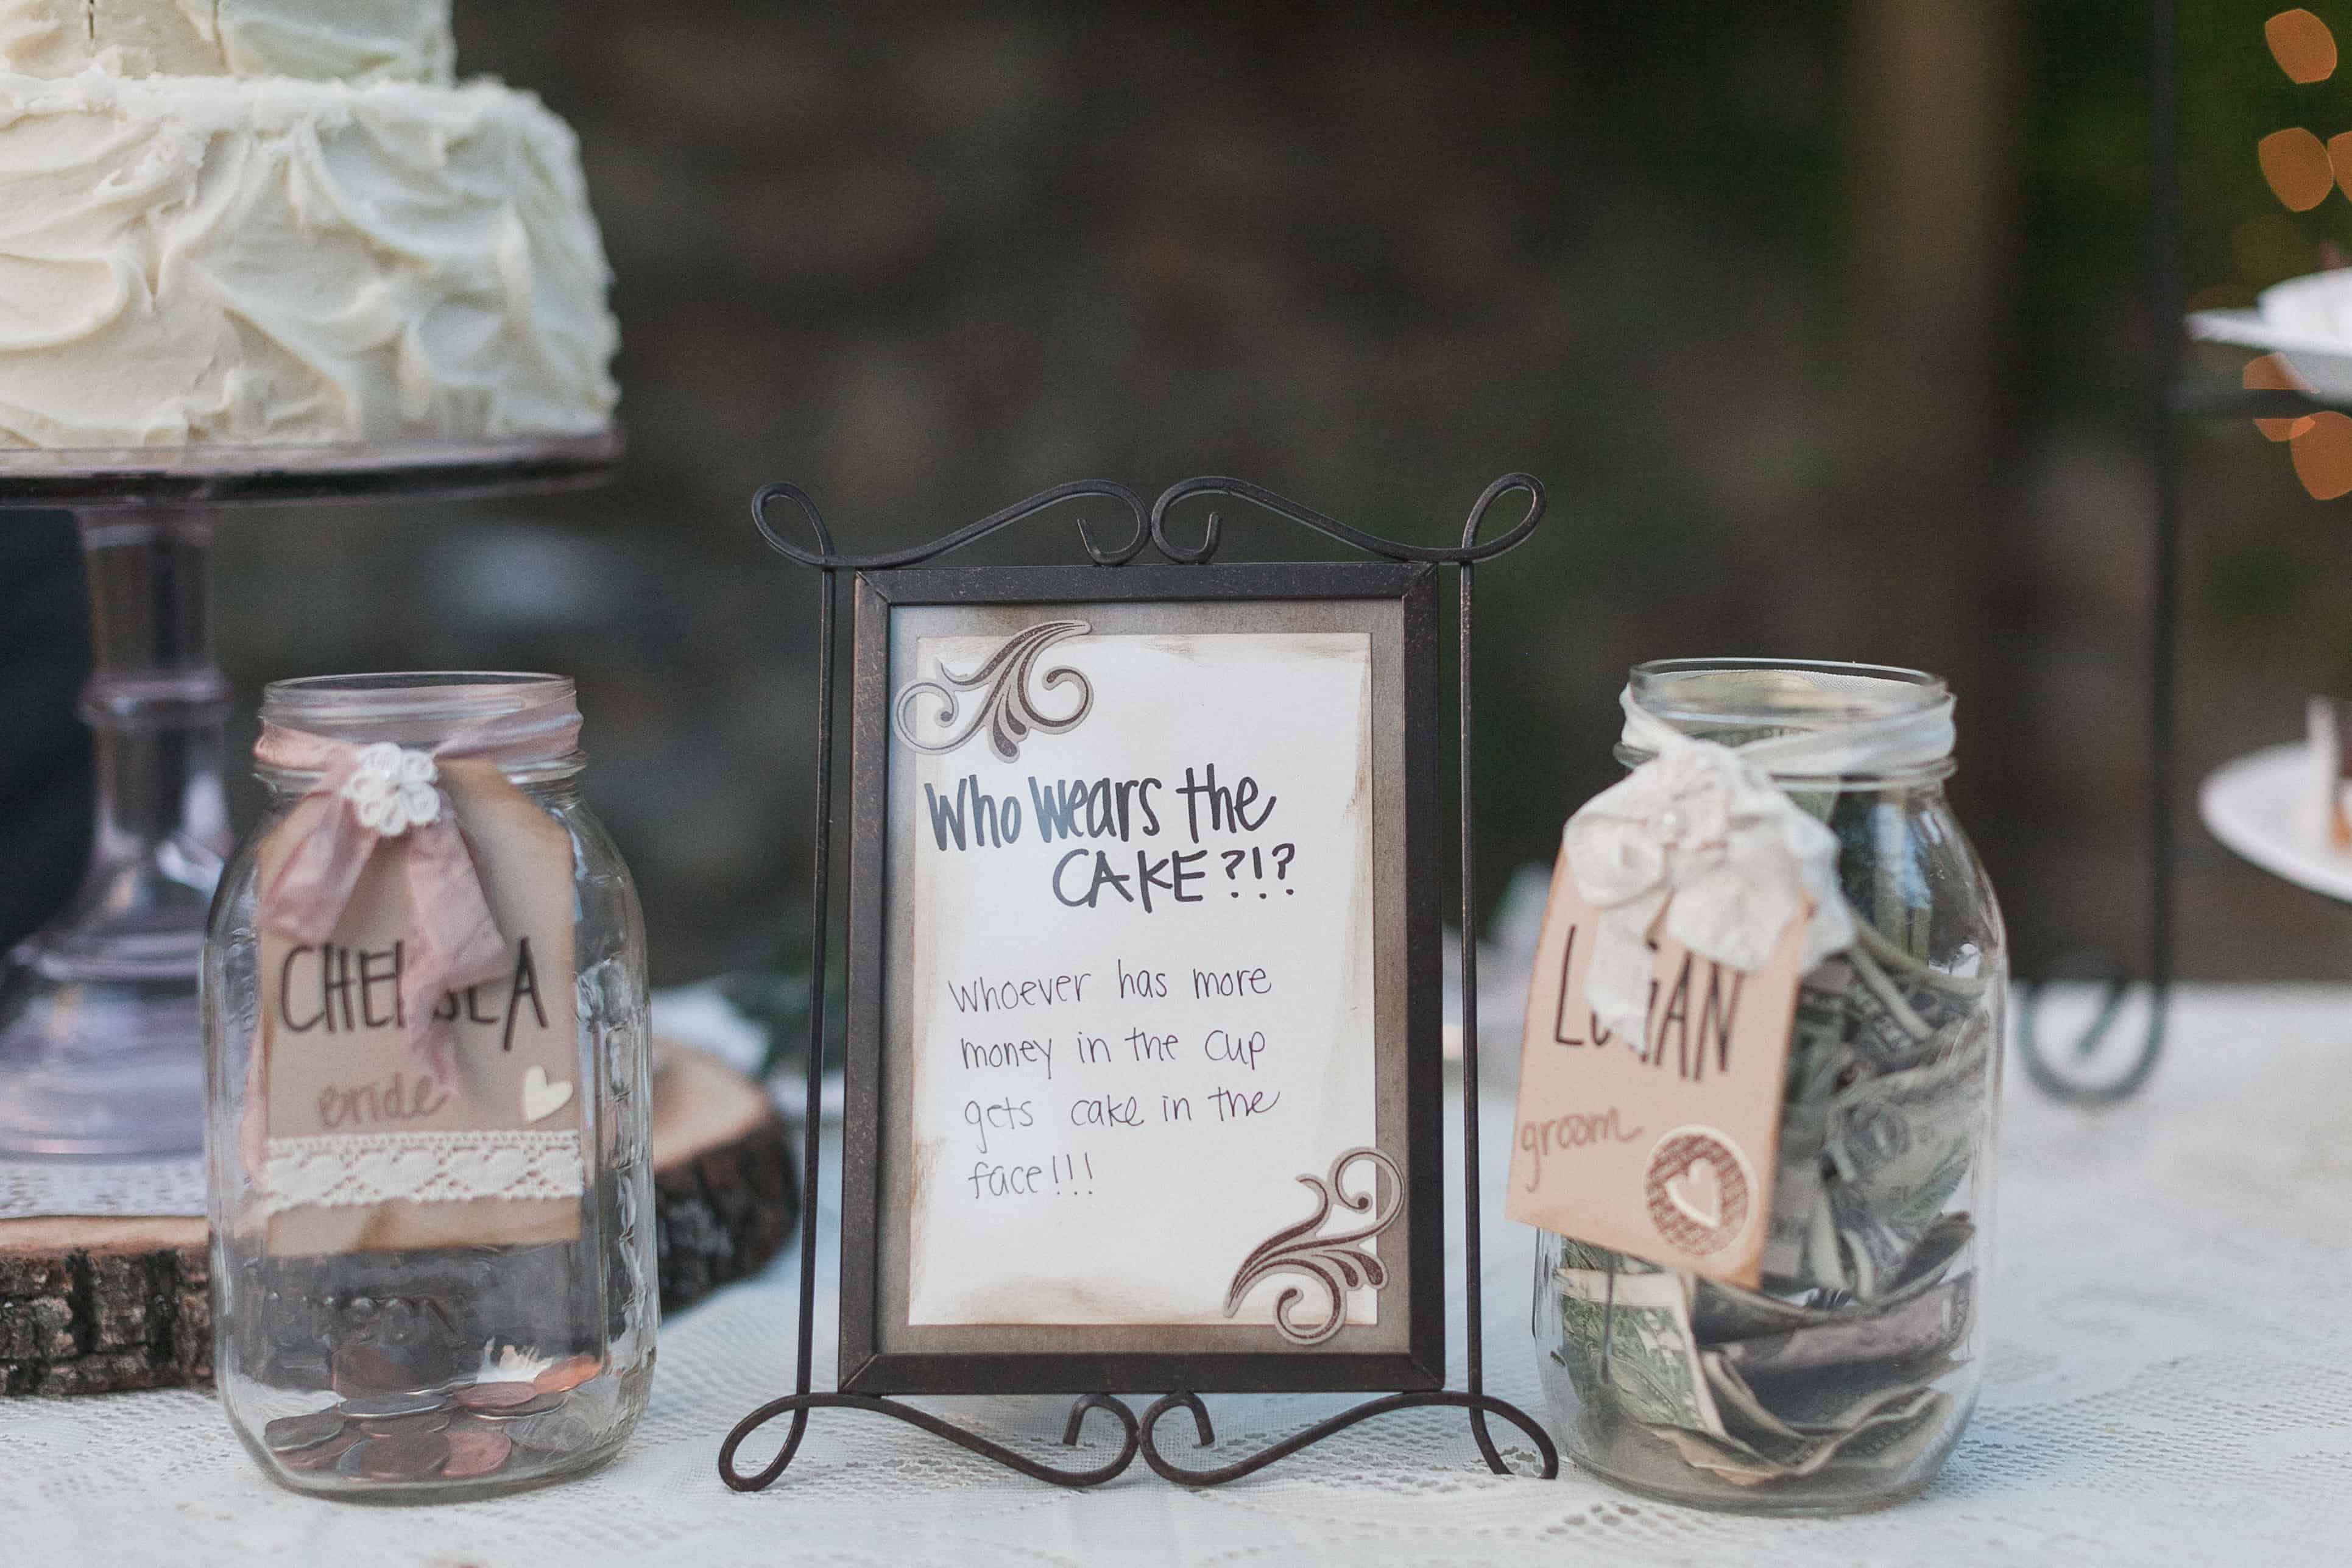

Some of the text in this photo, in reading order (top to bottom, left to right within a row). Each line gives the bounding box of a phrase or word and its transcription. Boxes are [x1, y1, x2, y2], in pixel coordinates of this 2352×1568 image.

[923, 774, 1021, 852] Who
[1175, 763, 1277, 844] the
[1118, 959, 1168, 999] has
[1193, 967, 1273, 999] more
[1555, 924, 1745, 1081] LAN
[961, 1037, 1053, 1079] money
[1077, 1031, 1112, 1064] in
[1125, 1027, 1179, 1062] the
[964, 1086, 1281, 1154] gets cake in the
[1522, 1107, 1644, 1192] groom
[969, 1152, 1093, 1199] face!!!
